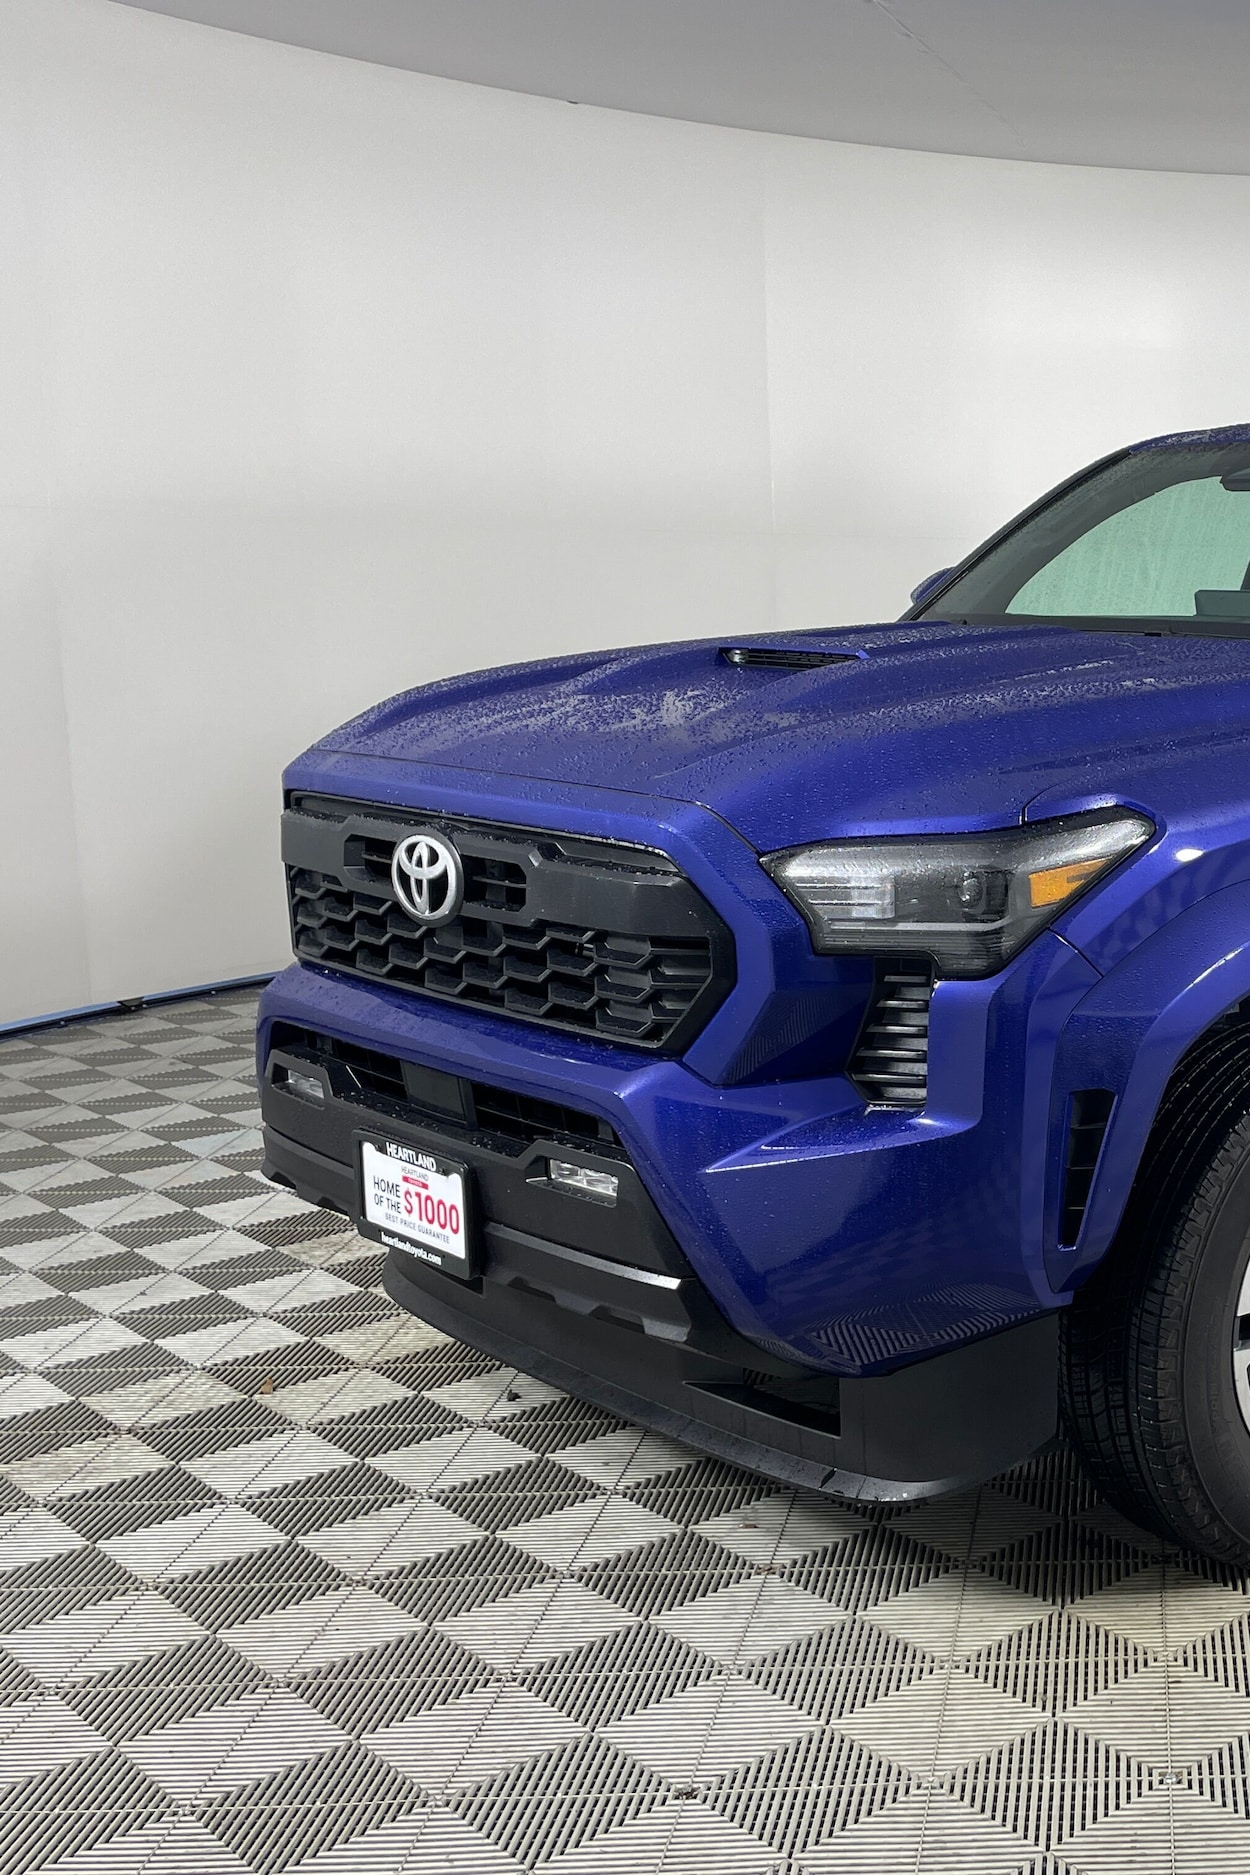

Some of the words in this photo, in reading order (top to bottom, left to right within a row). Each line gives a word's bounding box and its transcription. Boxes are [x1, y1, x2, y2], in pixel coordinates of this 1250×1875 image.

[386, 1142, 436, 1171] HEARTLAND
[373, 1175, 401, 1198] HOME
[401, 1165, 429, 1182] HEARTLAND
[374, 1193, 384, 1206] OF
[386, 1198, 402, 1214] THE
[404, 1187, 460, 1235] $1000
[385, 1212, 399, 1223] BEST
[400, 1217, 416, 1230] PRICE
[418, 1223, 450, 1244] GUARANTEE
[381, 1231, 442, 1266] heartlandtoyota.com
